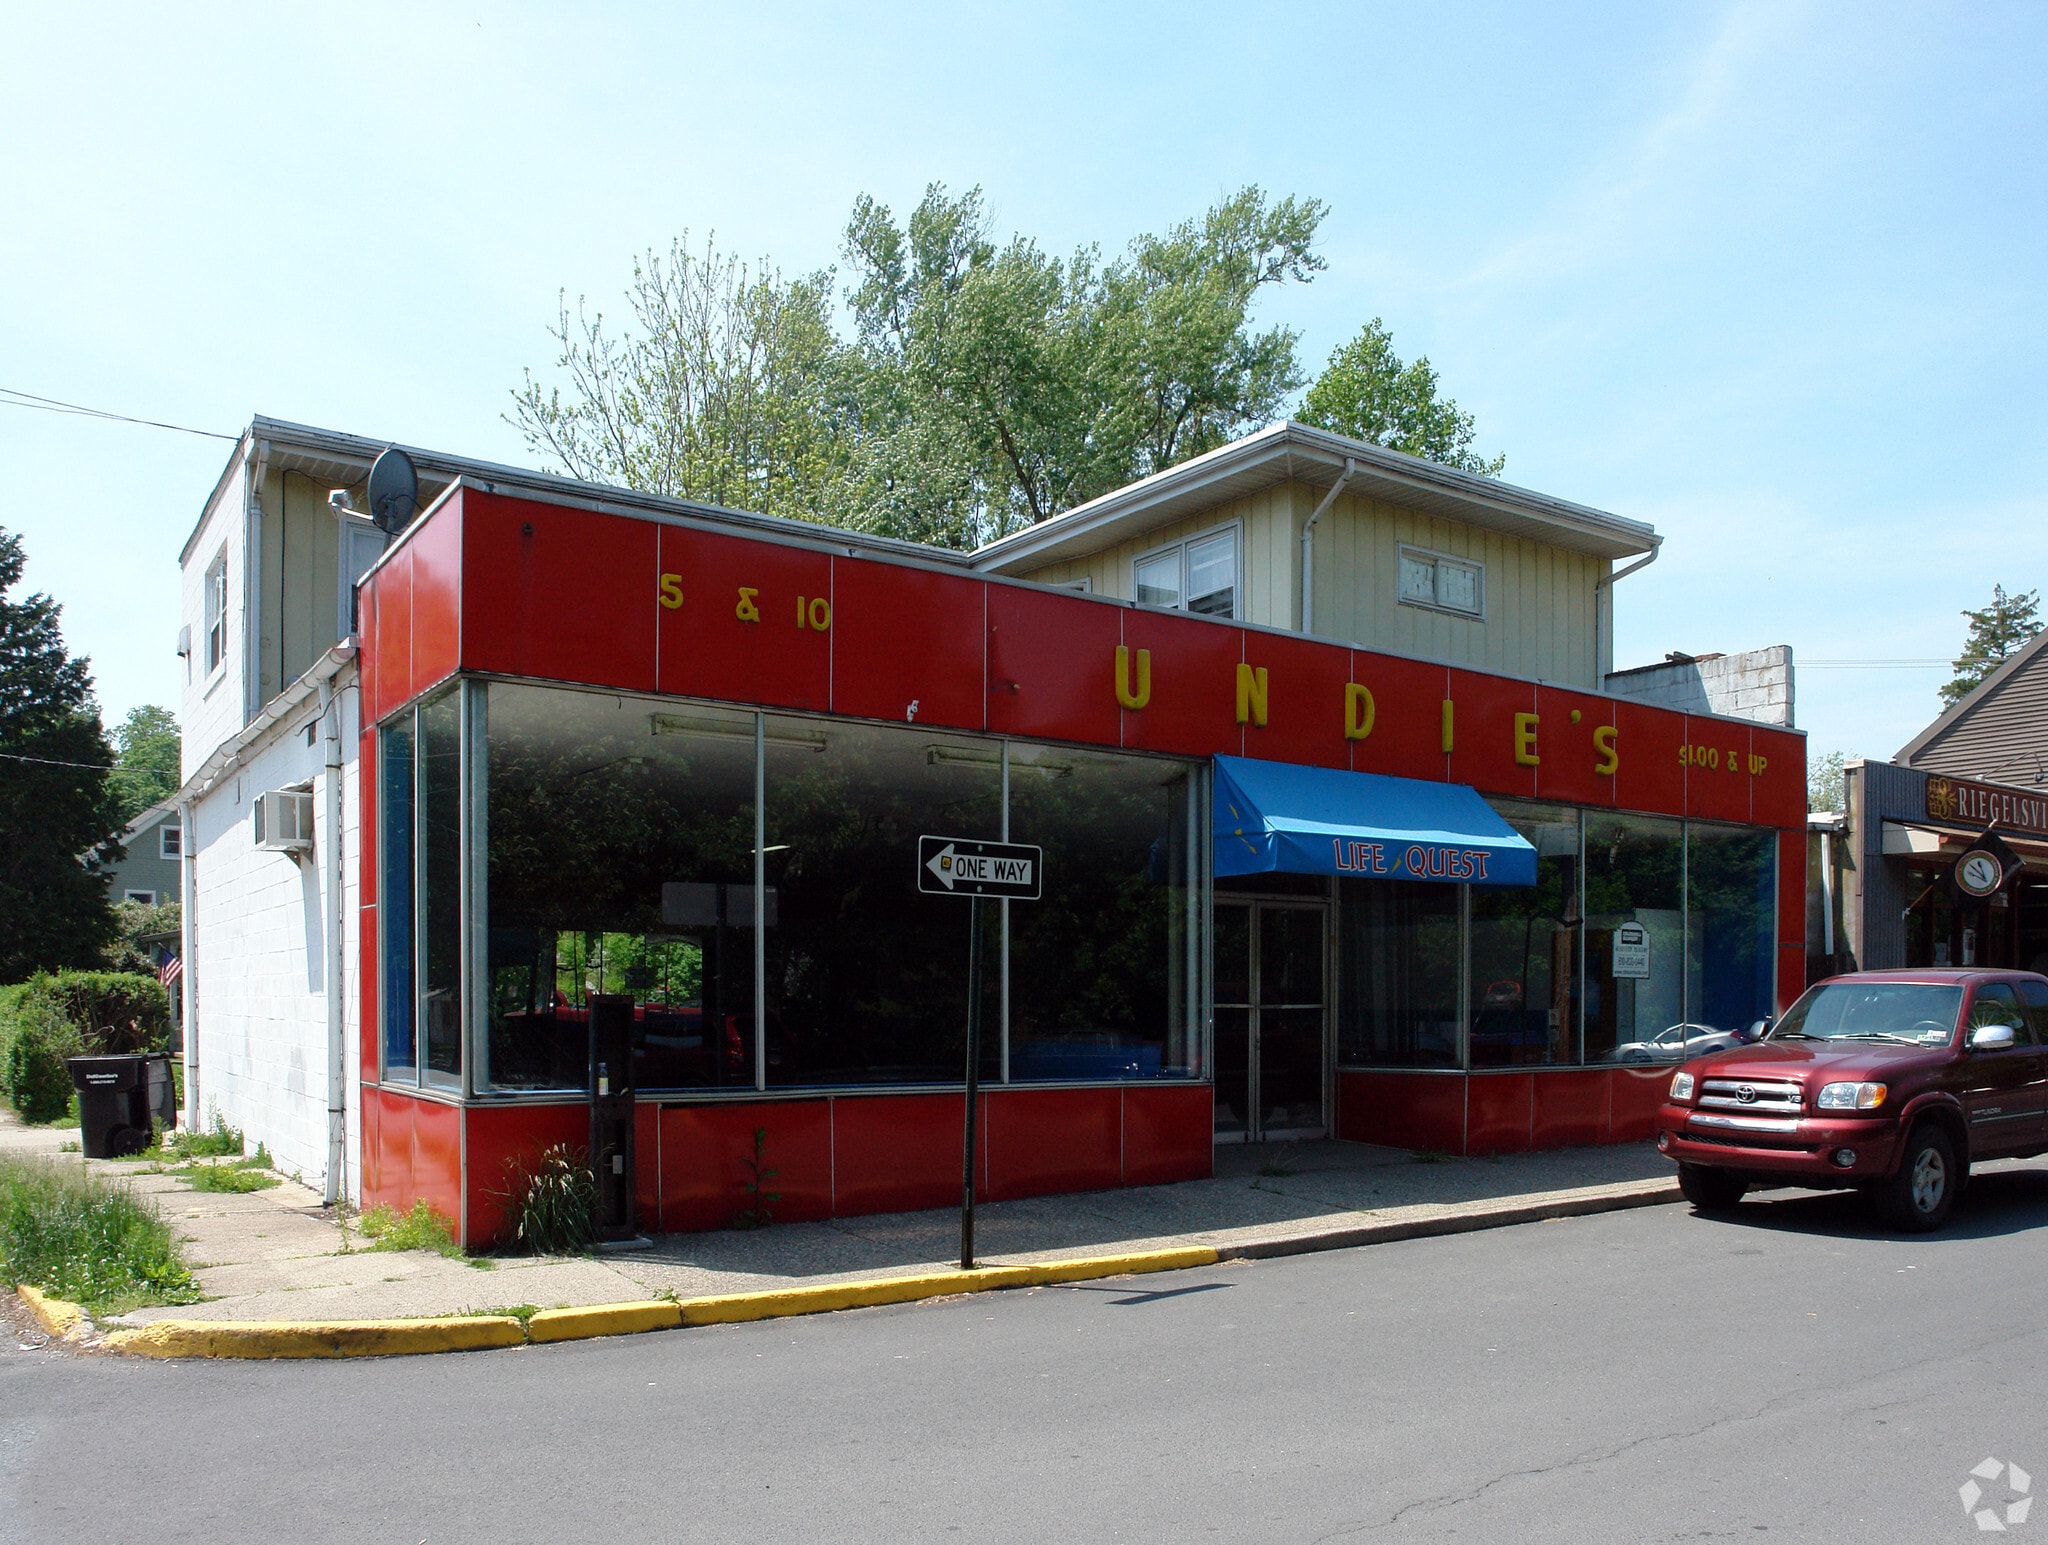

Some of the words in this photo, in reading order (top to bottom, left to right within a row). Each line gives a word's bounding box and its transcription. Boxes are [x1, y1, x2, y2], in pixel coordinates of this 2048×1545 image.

[659, 573, 684, 609] 5
[735, 587, 760, 623] &
[796, 596, 831, 632] 10
[1115, 645, 1618, 776] UNDIE'S
[1727, 751, 1738, 772] &
[1748, 754, 1768, 777] UP
[956, 857, 987, 879] ONE
[994, 860, 1027, 881] WAY
[1333, 838, 1387, 874] LIFE
[1405, 845, 1491, 879] QUEST
